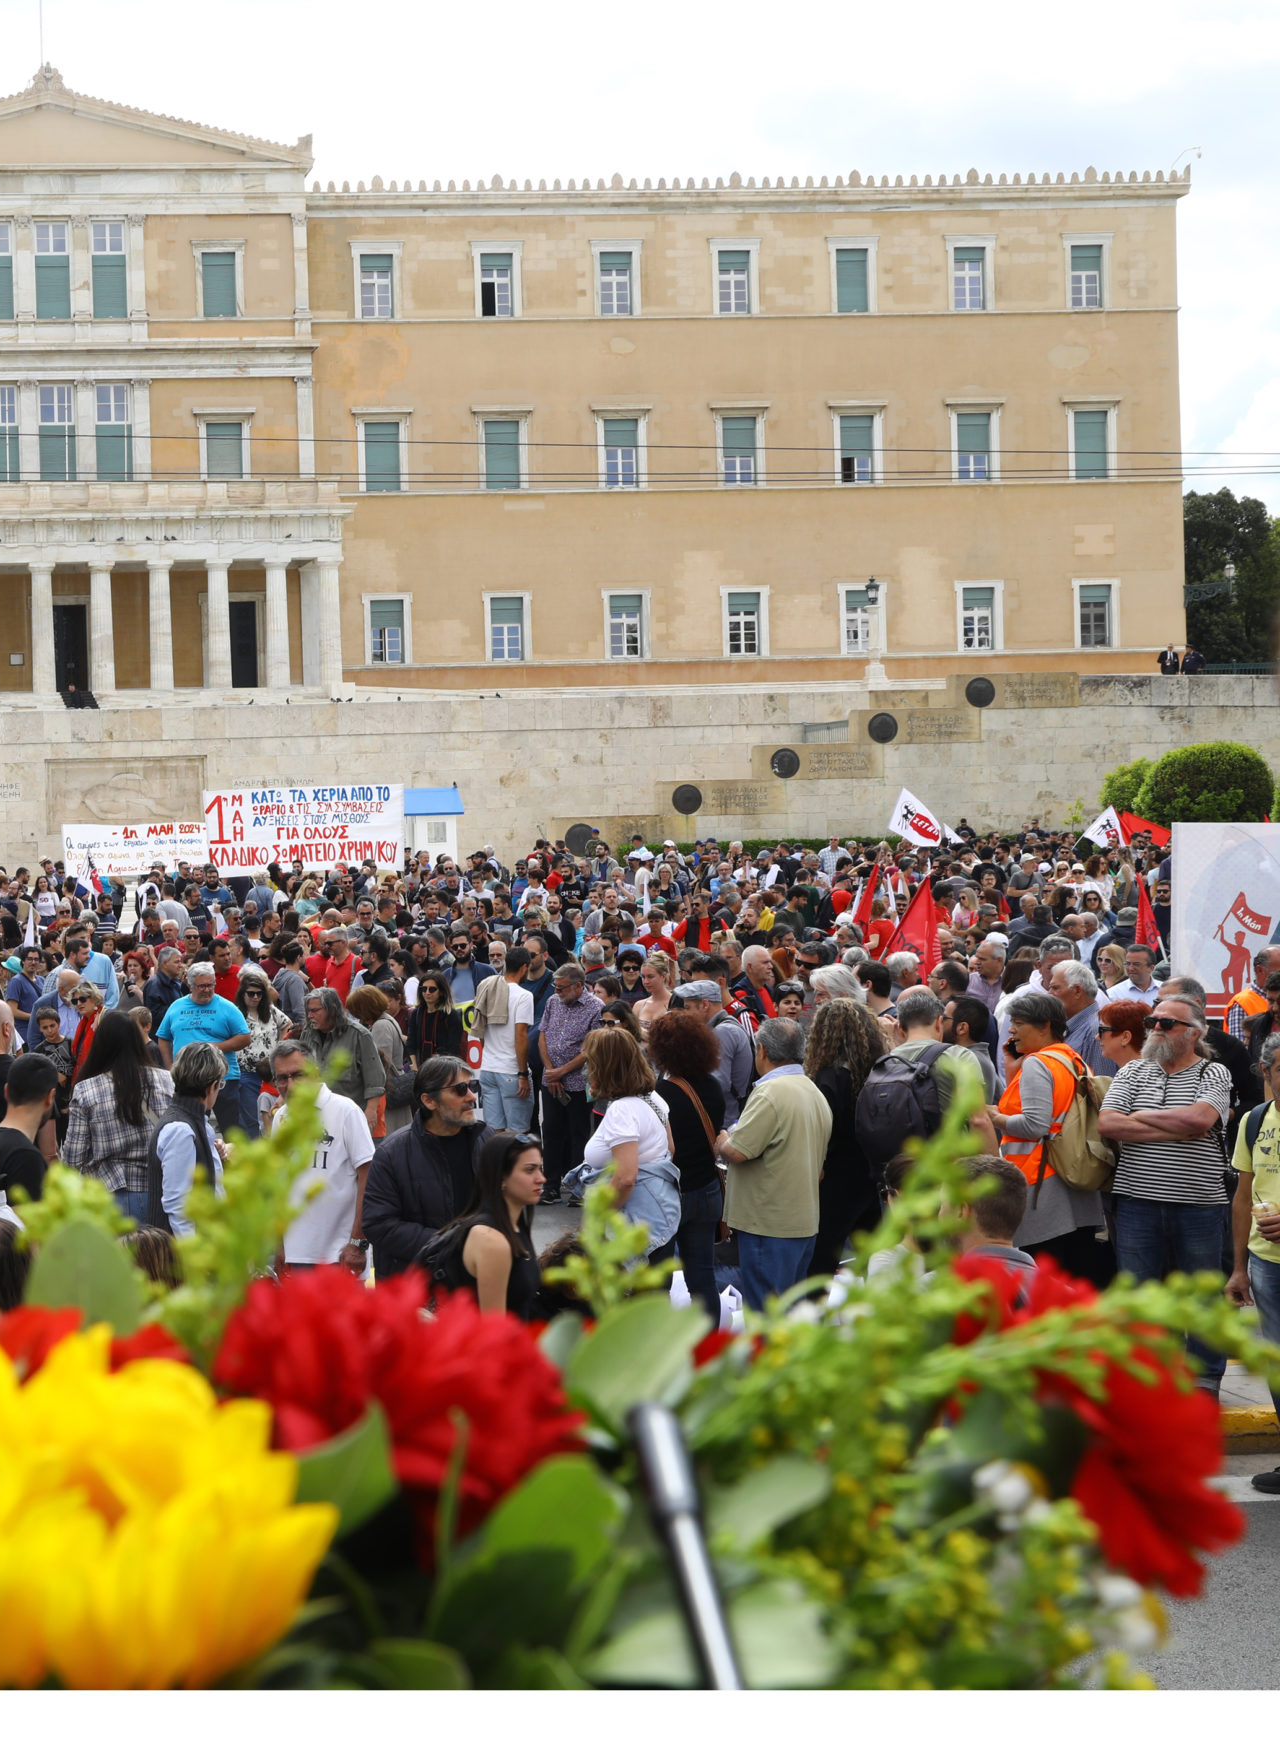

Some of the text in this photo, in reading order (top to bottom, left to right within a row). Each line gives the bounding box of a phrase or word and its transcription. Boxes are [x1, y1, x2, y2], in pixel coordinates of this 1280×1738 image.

[289, 789, 305, 803] ΤΑ
[312, 787, 348, 802] ΧΕΡΙΑ
[350, 787, 373, 802] ΑΠΟ
[376, 786, 390, 801] ΤΟ
[289, 804, 294, 814] &
[297, 804, 312, 814] ΤΙΣ
[303, 814, 328, 826] ΣΤΟΥΣ
[331, 812, 371, 825] ΜΙΣΘΟΥΣ
[146, 824, 174, 838] ΜΑΗ
[178, 824, 200, 834] 2024
[276, 825, 350, 840] ΓΙΑ ΟΛΟΥΣ
[209, 846, 270, 868] ΚΛΑΔΙΚΟ
